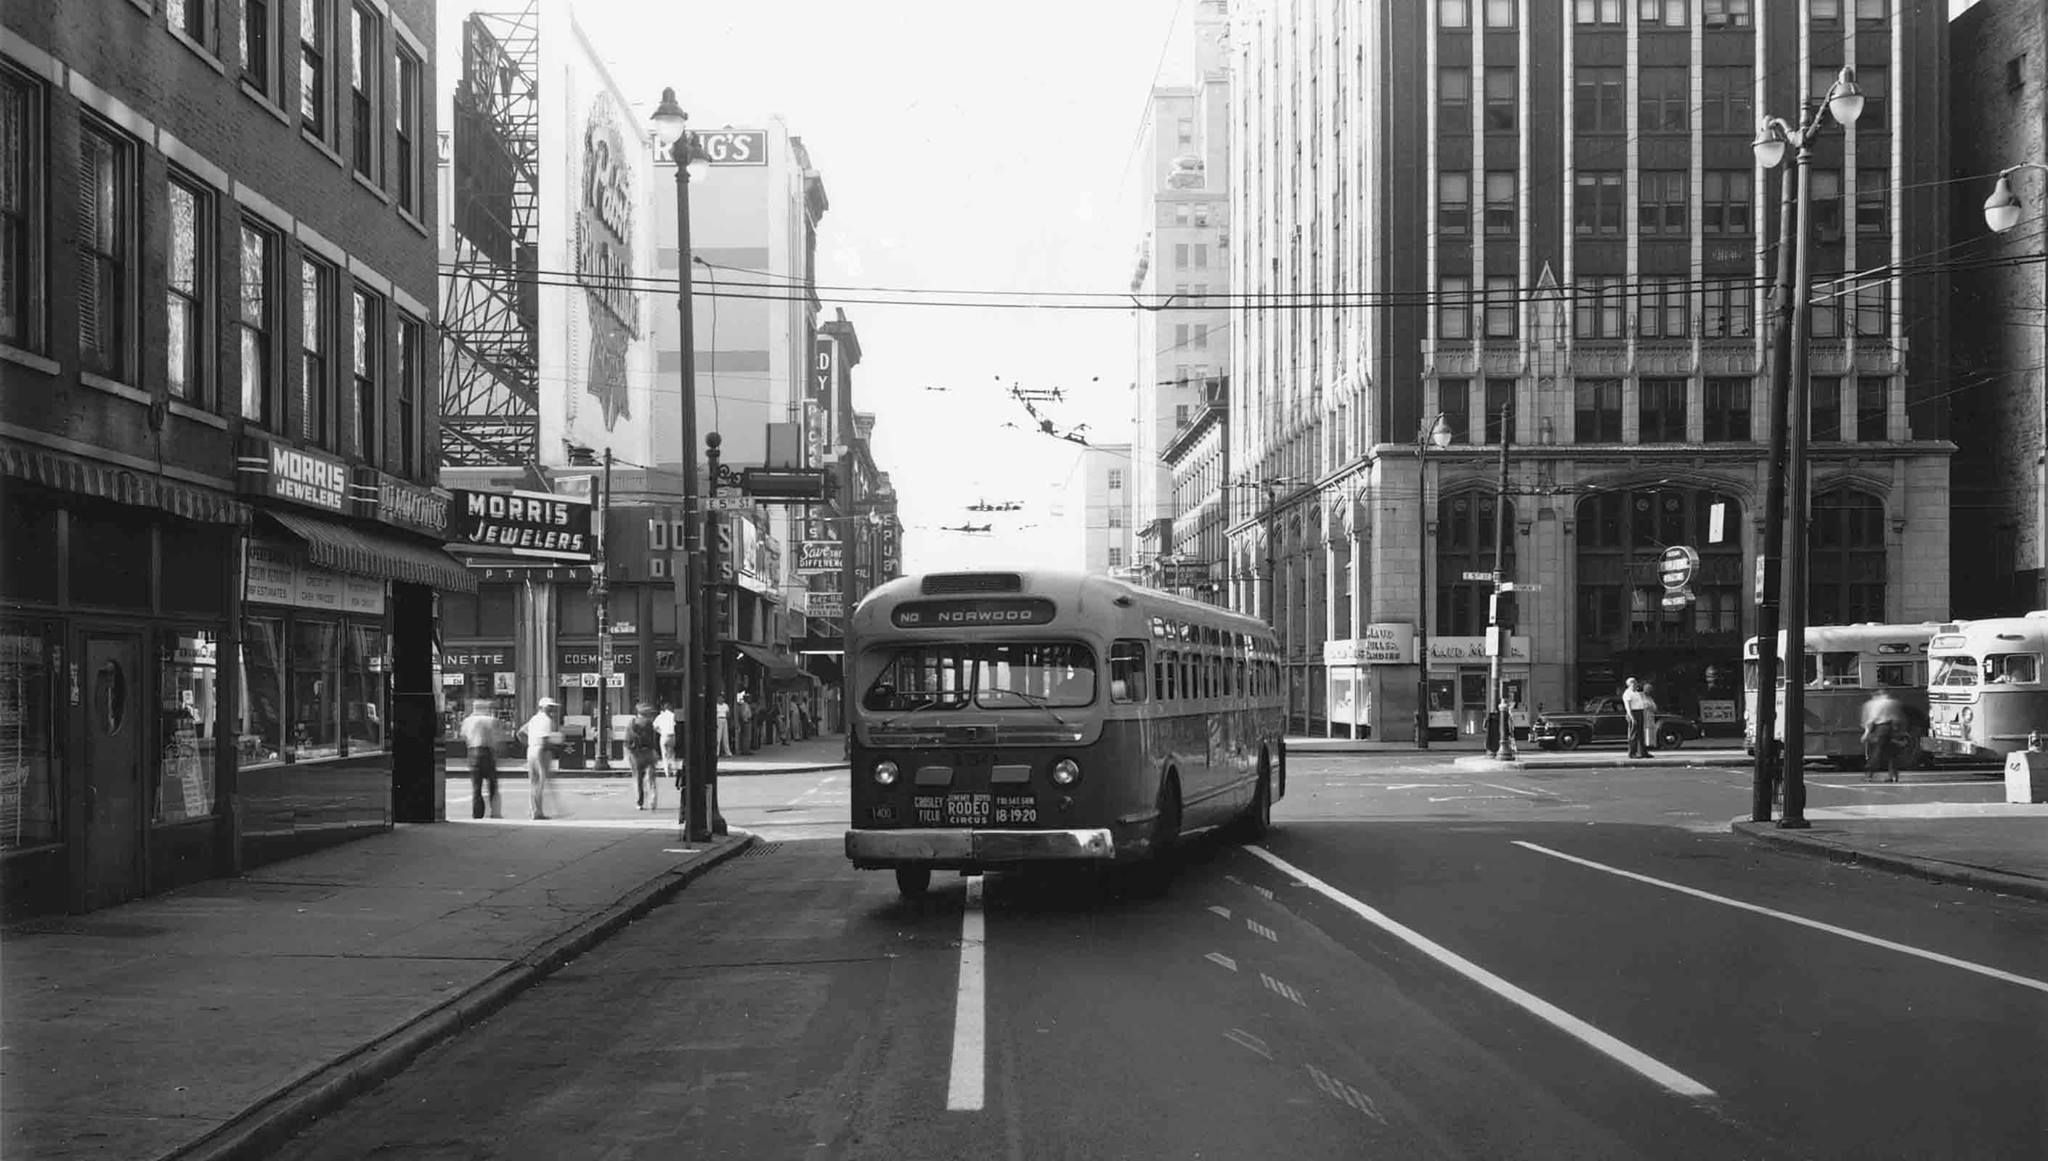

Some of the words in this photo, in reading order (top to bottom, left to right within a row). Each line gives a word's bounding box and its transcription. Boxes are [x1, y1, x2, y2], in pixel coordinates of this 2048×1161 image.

[653, 135, 750, 161] RG'S
[273, 446, 345, 494] MORRIS
[277, 478, 342, 509] JEWELERS
[468, 493, 568, 526] MORRIS
[469, 520, 584, 551] JEWELERS
[938, 610, 1032, 622] NORWOOD
[564, 655, 633, 665] COSMICS
[948, 802, 990, 815] RODEO
[949, 816, 988, 824] CIRCUS
